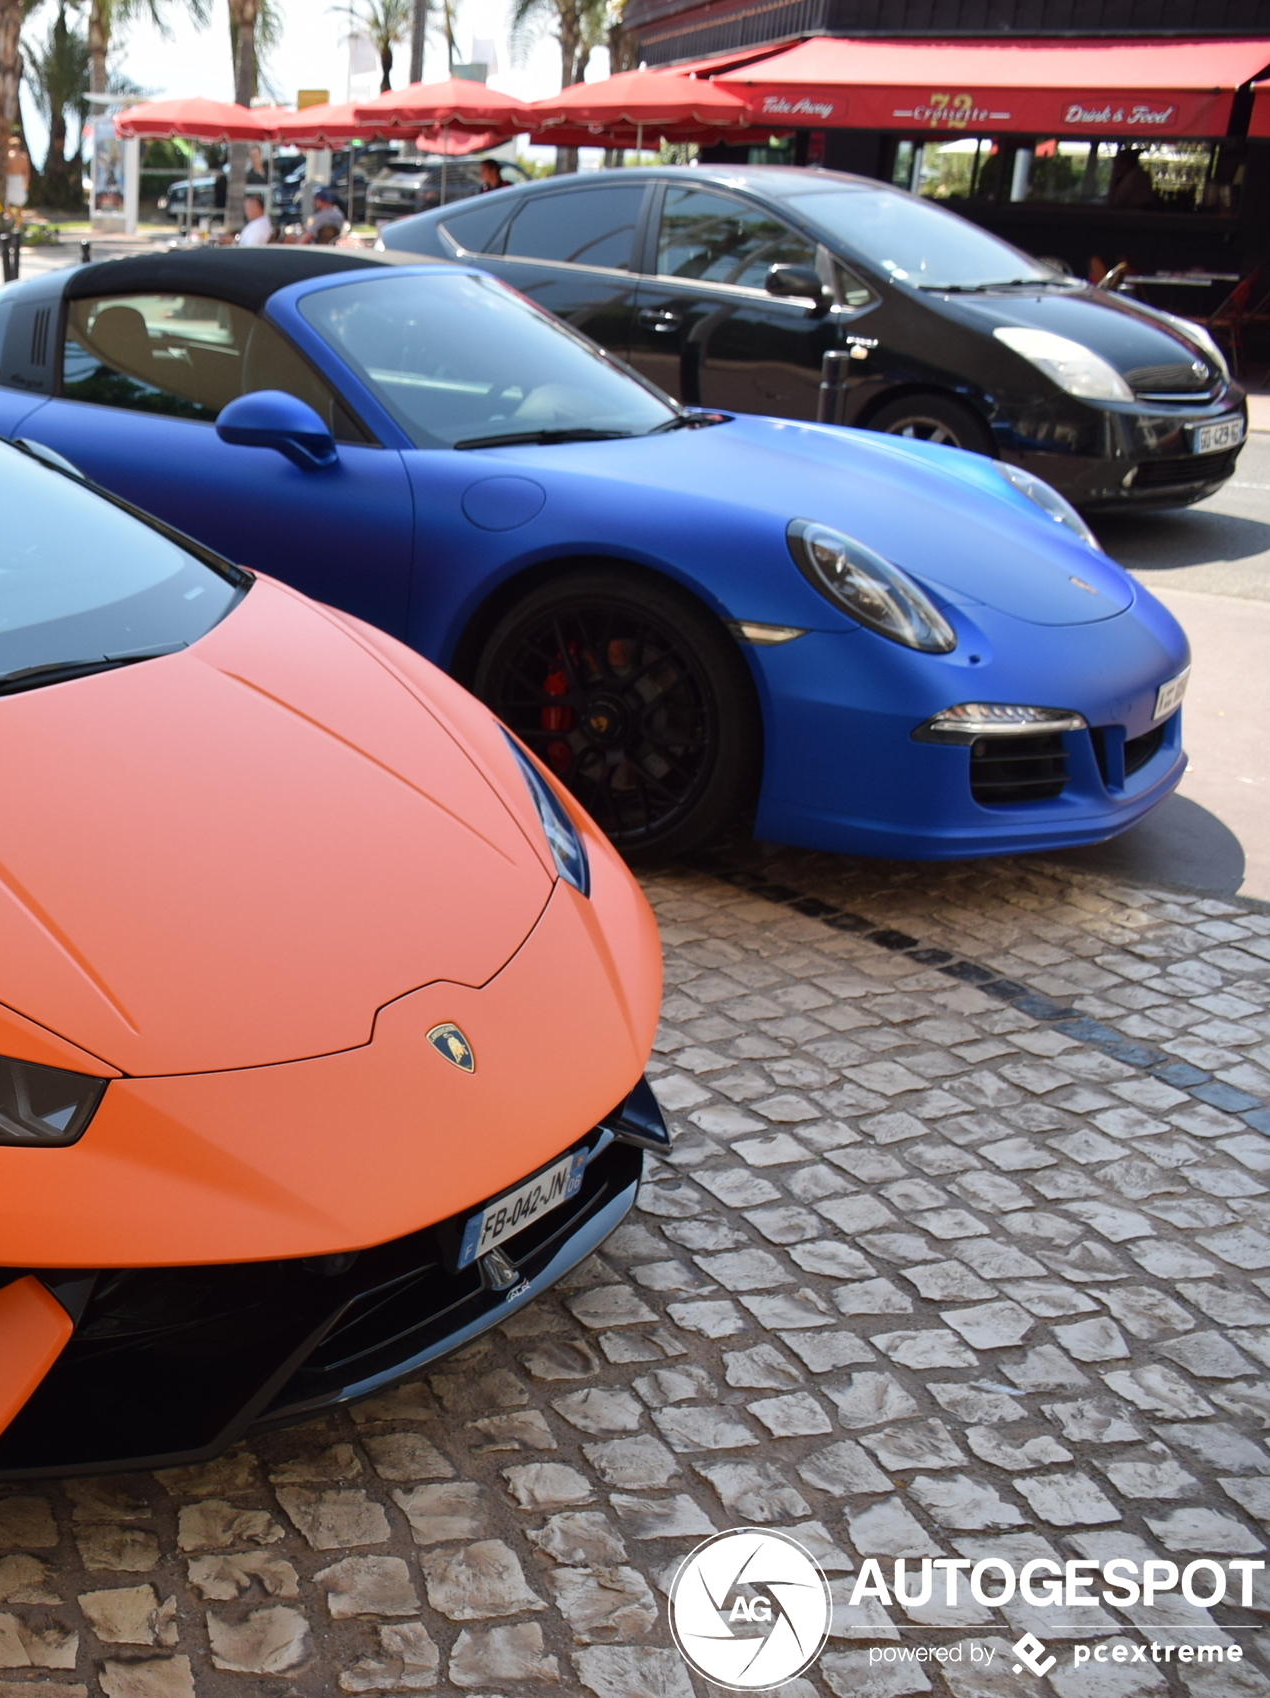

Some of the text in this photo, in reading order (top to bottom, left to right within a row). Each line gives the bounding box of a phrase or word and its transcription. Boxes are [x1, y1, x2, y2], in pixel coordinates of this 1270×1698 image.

[762, 95, 834, 119] Take Away
[913, 105, 989, 121] Croisette
[930, 93, 973, 128] 72
[1065, 104, 1173, 125] Drink & Food
[481, 1167, 583, 1246] FB-042-JN 06
[464, 1243, 474, 1261] F
